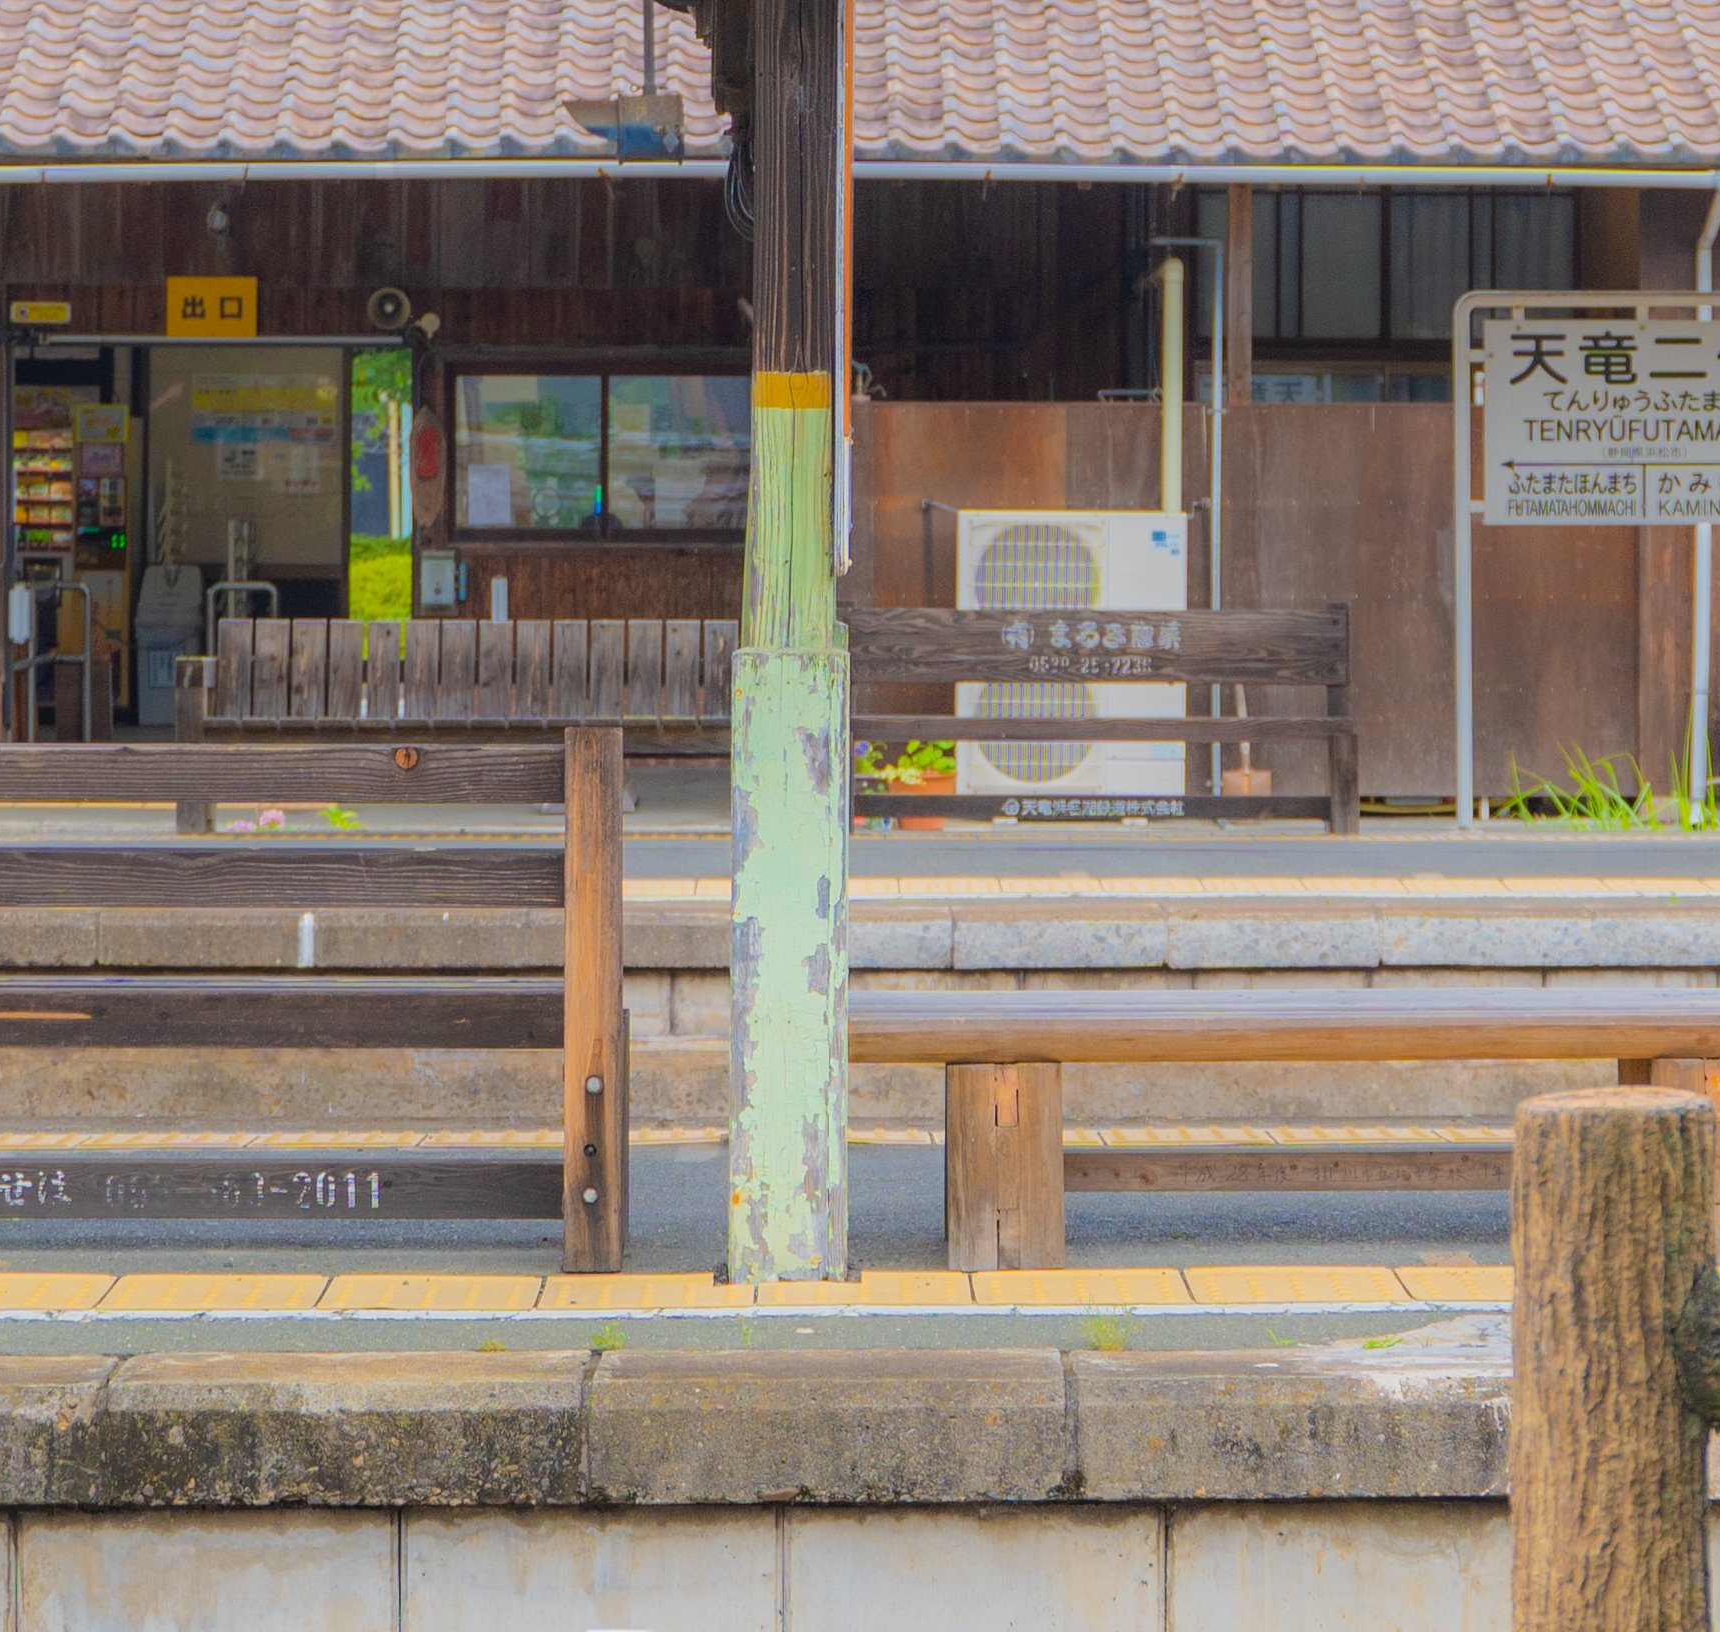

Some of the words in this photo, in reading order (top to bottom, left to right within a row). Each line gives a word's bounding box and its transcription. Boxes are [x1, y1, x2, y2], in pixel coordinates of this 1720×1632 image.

[182, 296, 243, 320] 出口
[1508, 472, 1638, 495] ふたまたほんまち
[1508, 499, 1637, 518] FUTAMATAHOMMACHI
[1021, 798, 1186, 817] 天竜浜名湖鉄道株式会社
